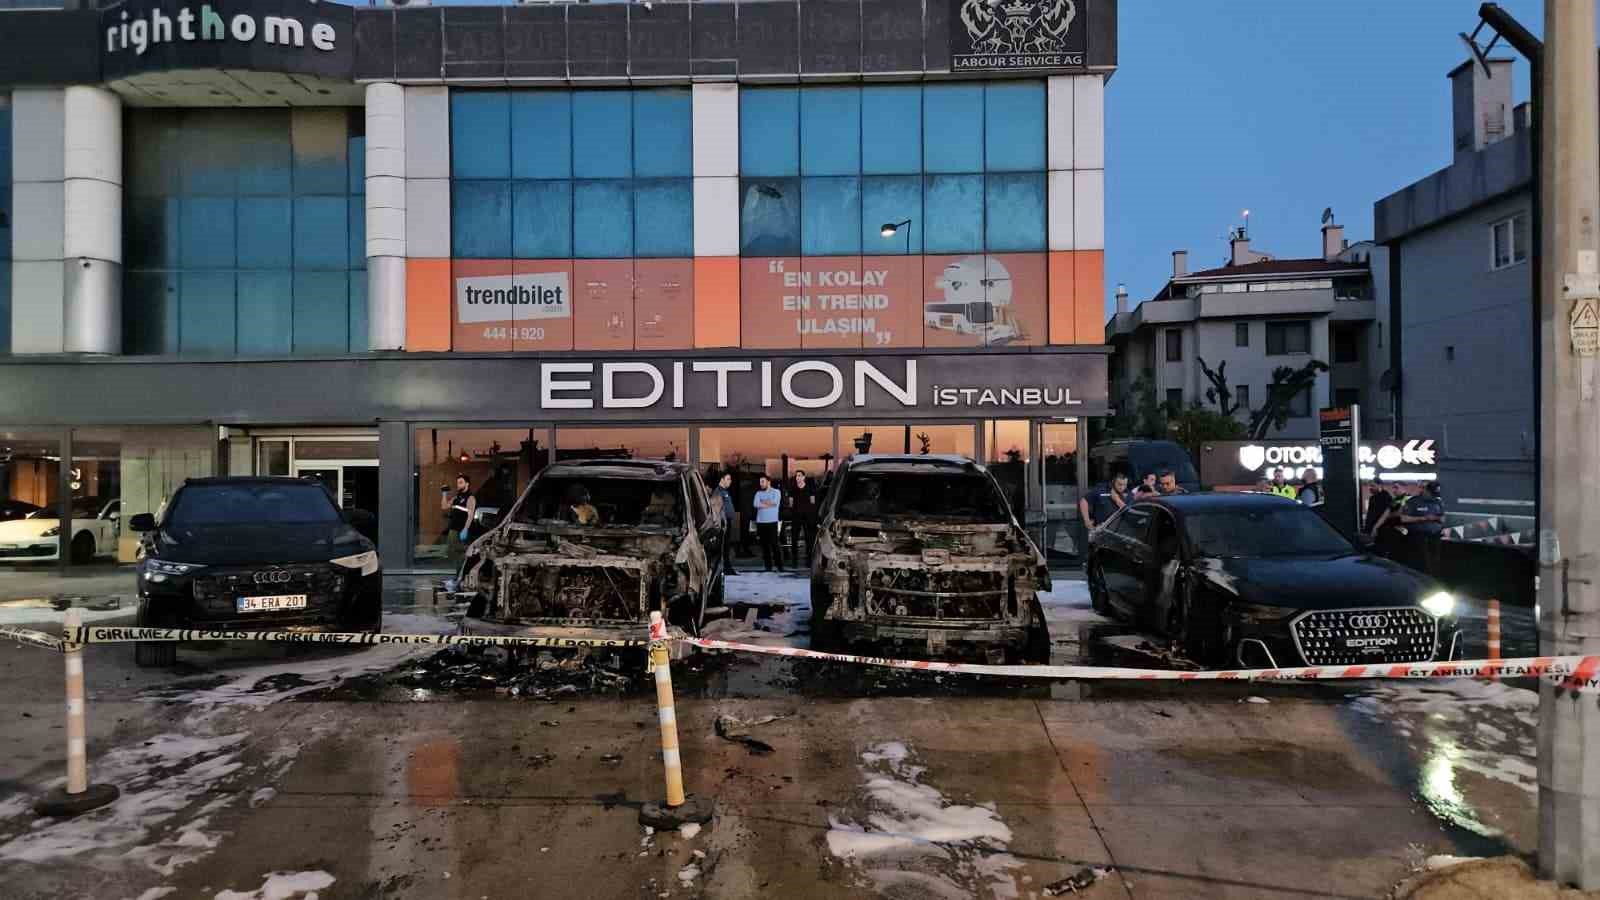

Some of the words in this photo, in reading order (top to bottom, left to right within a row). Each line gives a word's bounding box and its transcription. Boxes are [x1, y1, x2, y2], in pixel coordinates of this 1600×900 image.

[106, 4, 337, 56] righthome
[953, 56, 1006, 67] LABOUR
[1009, 56, 1060, 66] SERVICE
[1063, 55, 1082, 65] AG
[819, 270, 888, 287] KOLAY
[466, 284, 563, 305] trendbilet
[783, 296, 811, 311] EN
[818, 294, 889, 311] TREND
[483, 328, 506, 338] 444
[510, 328, 518, 339] 9
[520, 327, 545, 340] 920
[540, 359, 917, 409] EDITION
[933, 385, 1082, 406] İSTANBUL
[244, 599, 257, 609] 34
[261, 597, 280, 608] ERA
[287, 596, 304, 607] 201
[1345, 637, 1398, 647] EDITION
